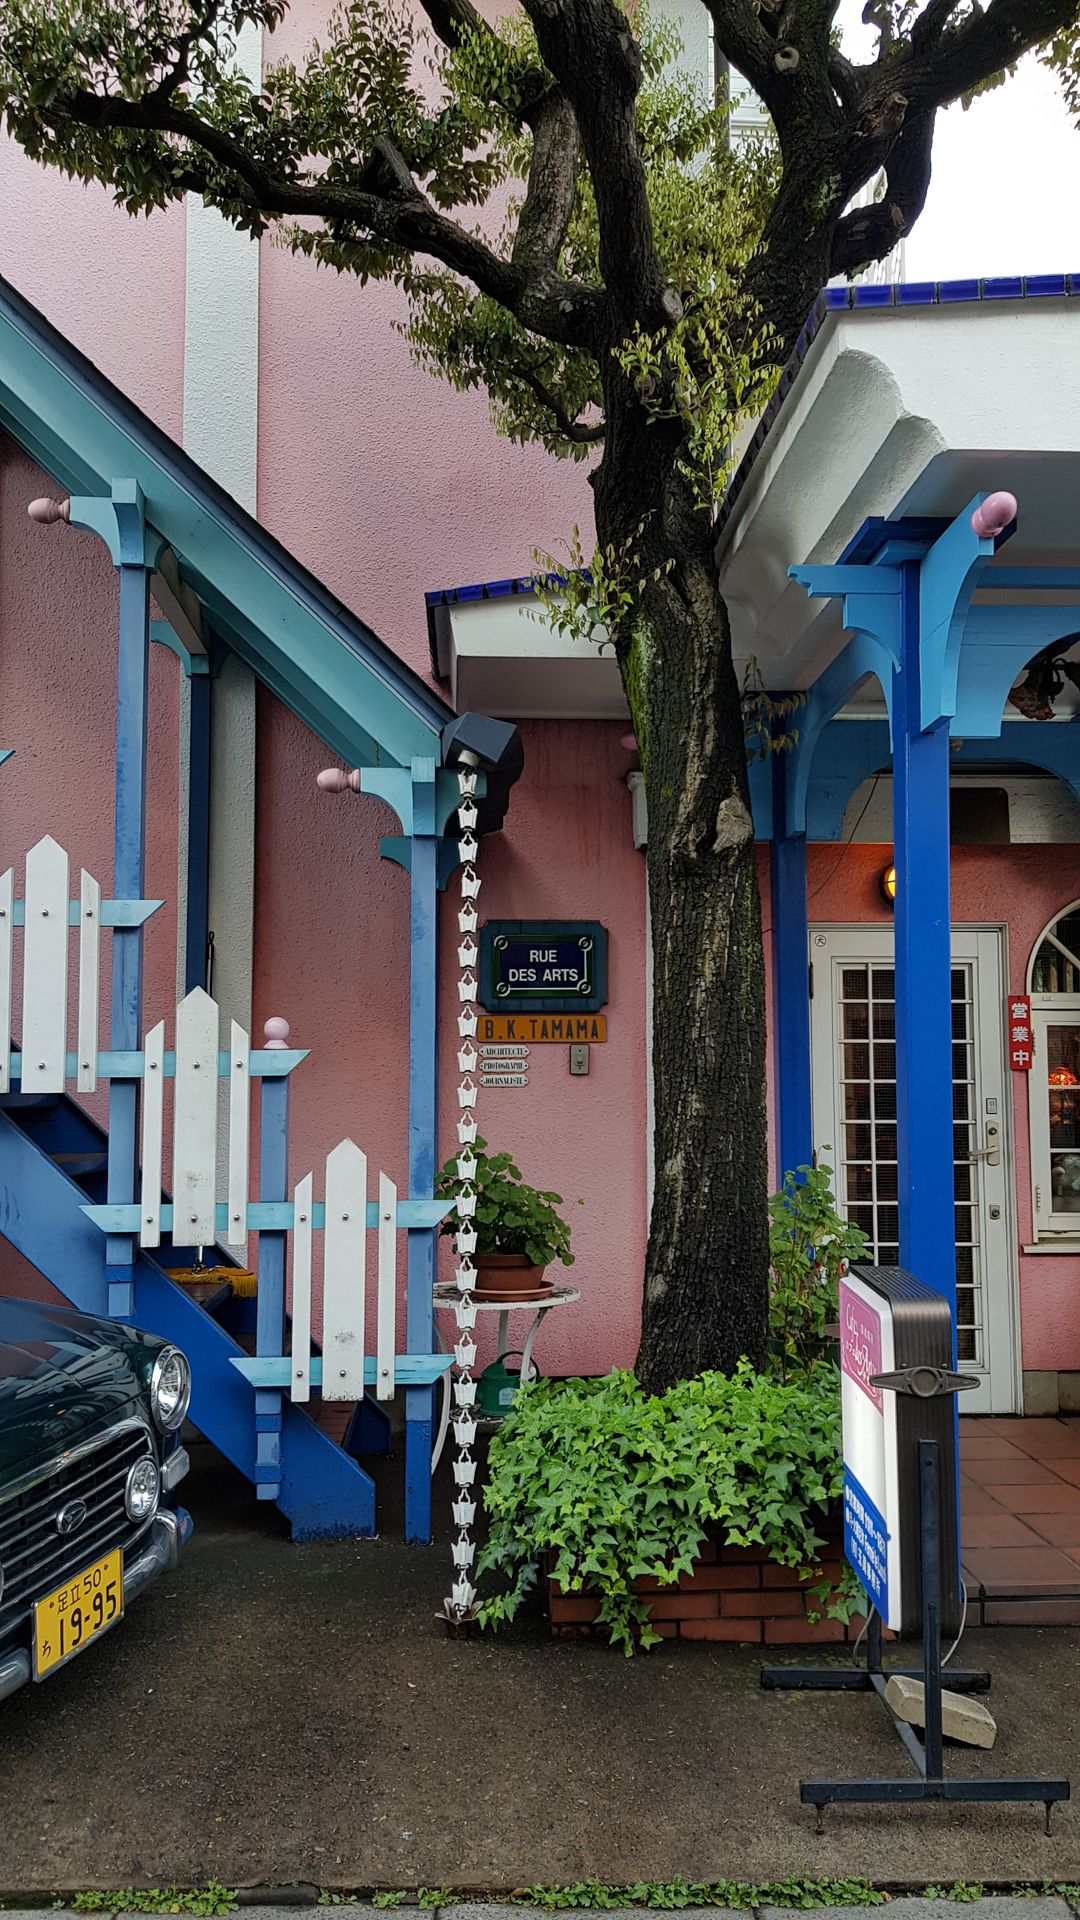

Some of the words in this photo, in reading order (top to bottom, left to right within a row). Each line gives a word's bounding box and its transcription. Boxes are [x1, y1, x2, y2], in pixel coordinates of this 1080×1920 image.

[529, 950, 557, 962] RUE
[508, 969, 536, 982] DES
[543, 969, 578, 982] ARTS
[1011, 1003, 1029, 1066] 営業中
[485, 1047, 525, 1056] ARCHITECTE
[484, 1061, 524, 1070] PHOTOGRAPHE
[484, 1076, 524, 1085] JOURNALISTE
[59, 1580, 117, 1656] 19-95
